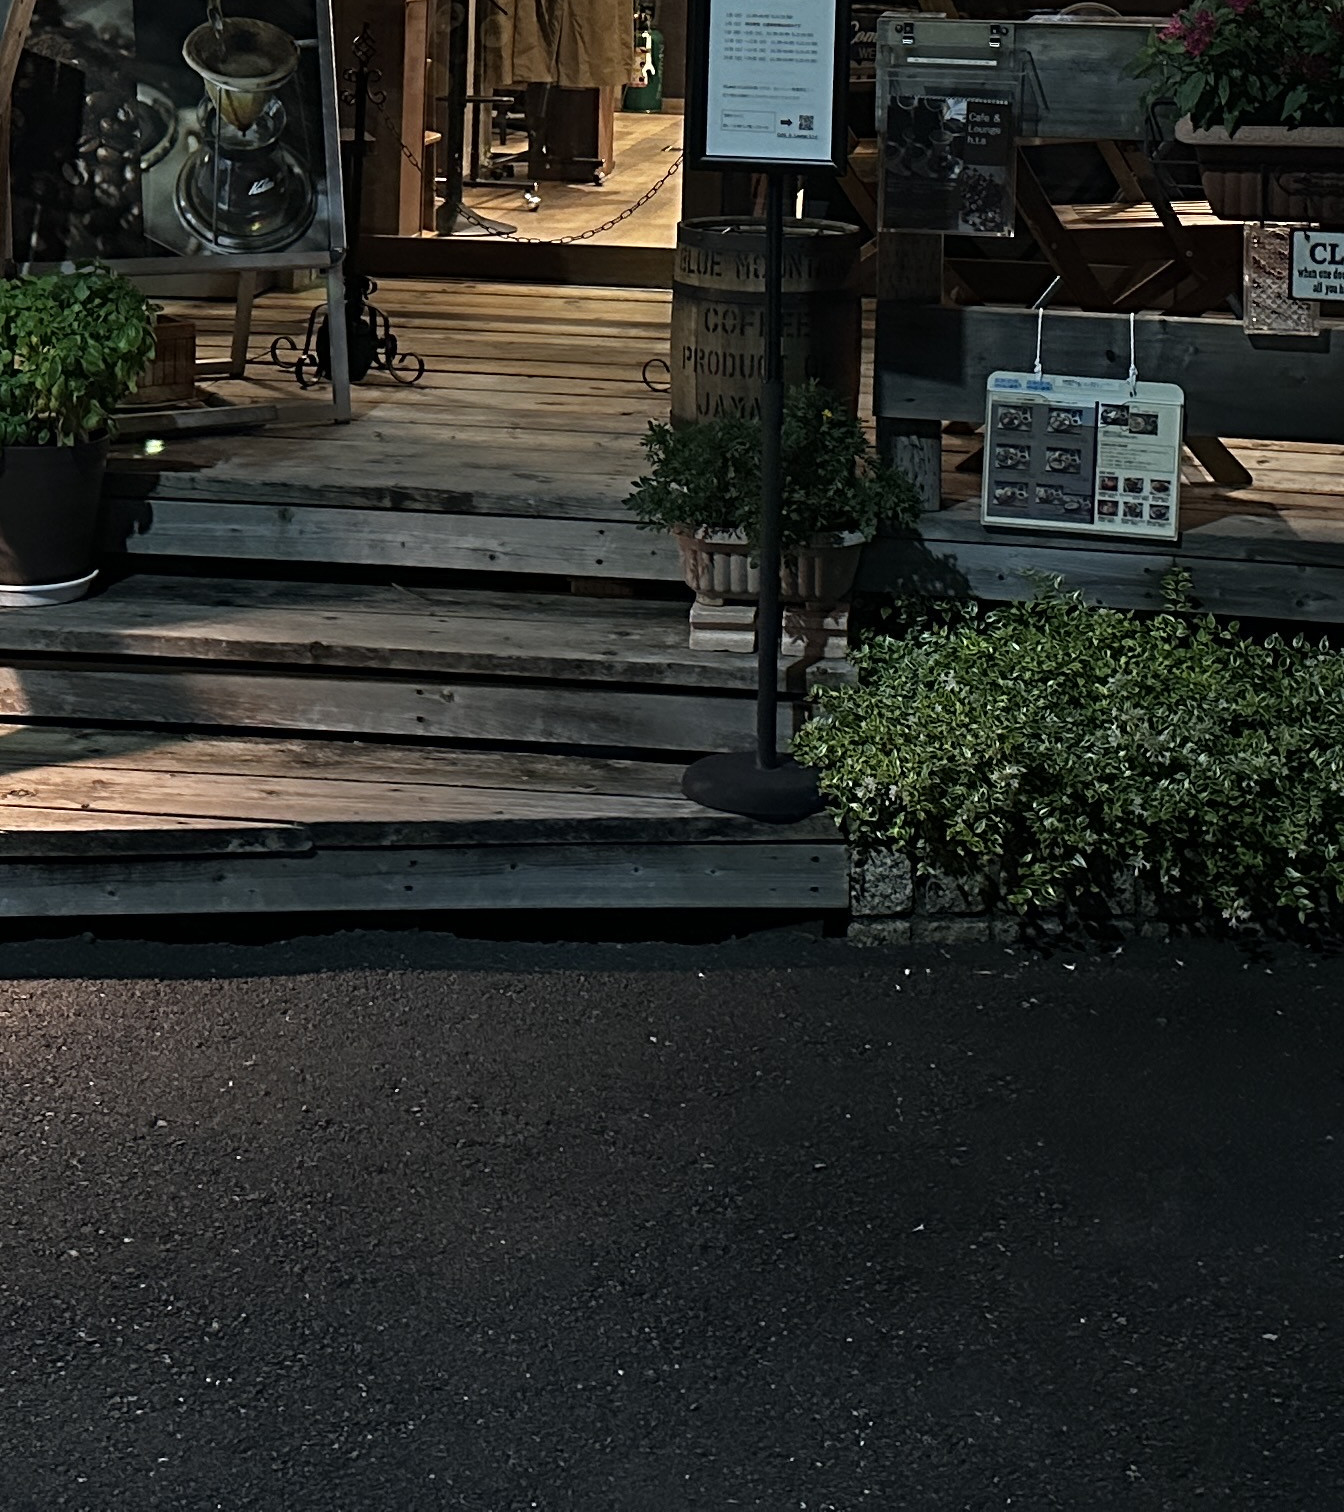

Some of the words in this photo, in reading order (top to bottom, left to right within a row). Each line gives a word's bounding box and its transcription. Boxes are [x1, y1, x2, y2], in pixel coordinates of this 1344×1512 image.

[968, 111, 991, 123] Cafe
[967, 124, 1002, 136] Lounge
[679, 245, 722, 277] BLUE
[1297, 267, 1317, 278] when
[1319, 270, 1331, 280] one
[1312, 282, 1323, 293] all
[1325, 284, 1338, 295] you
